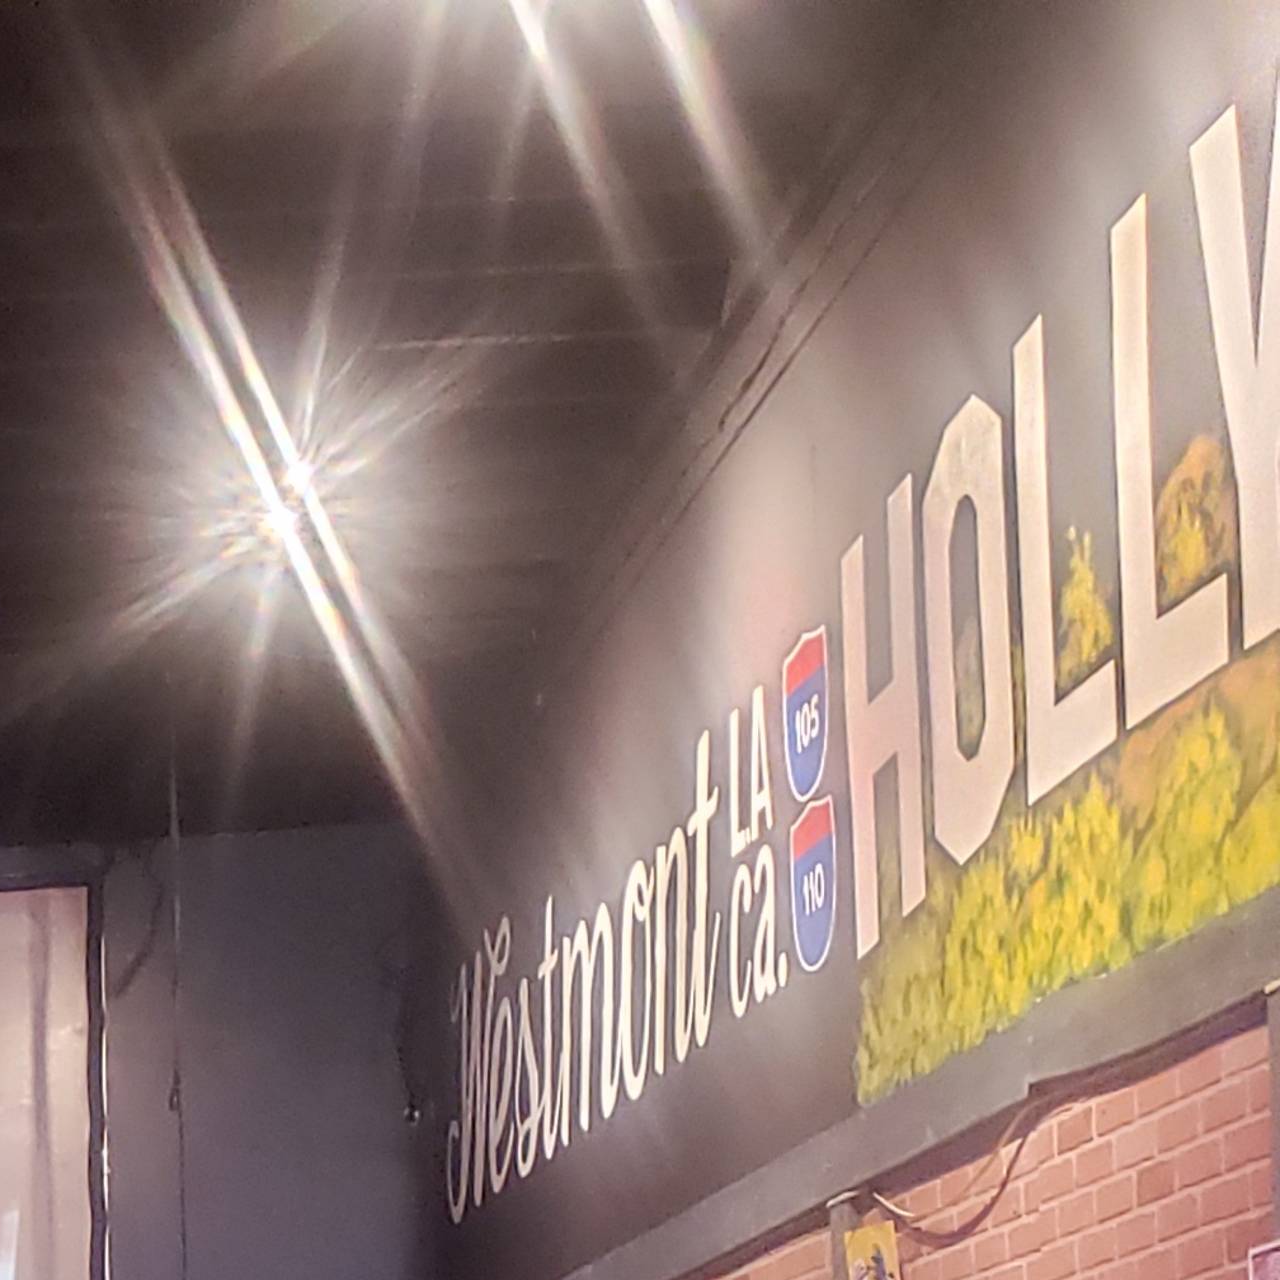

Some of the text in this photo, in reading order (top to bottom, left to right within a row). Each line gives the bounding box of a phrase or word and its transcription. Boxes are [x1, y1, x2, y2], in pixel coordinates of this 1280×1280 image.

[795, 694, 821, 755] 105
[802, 862, 826, 917] 110
[447, 729, 720, 1225] Westmont
